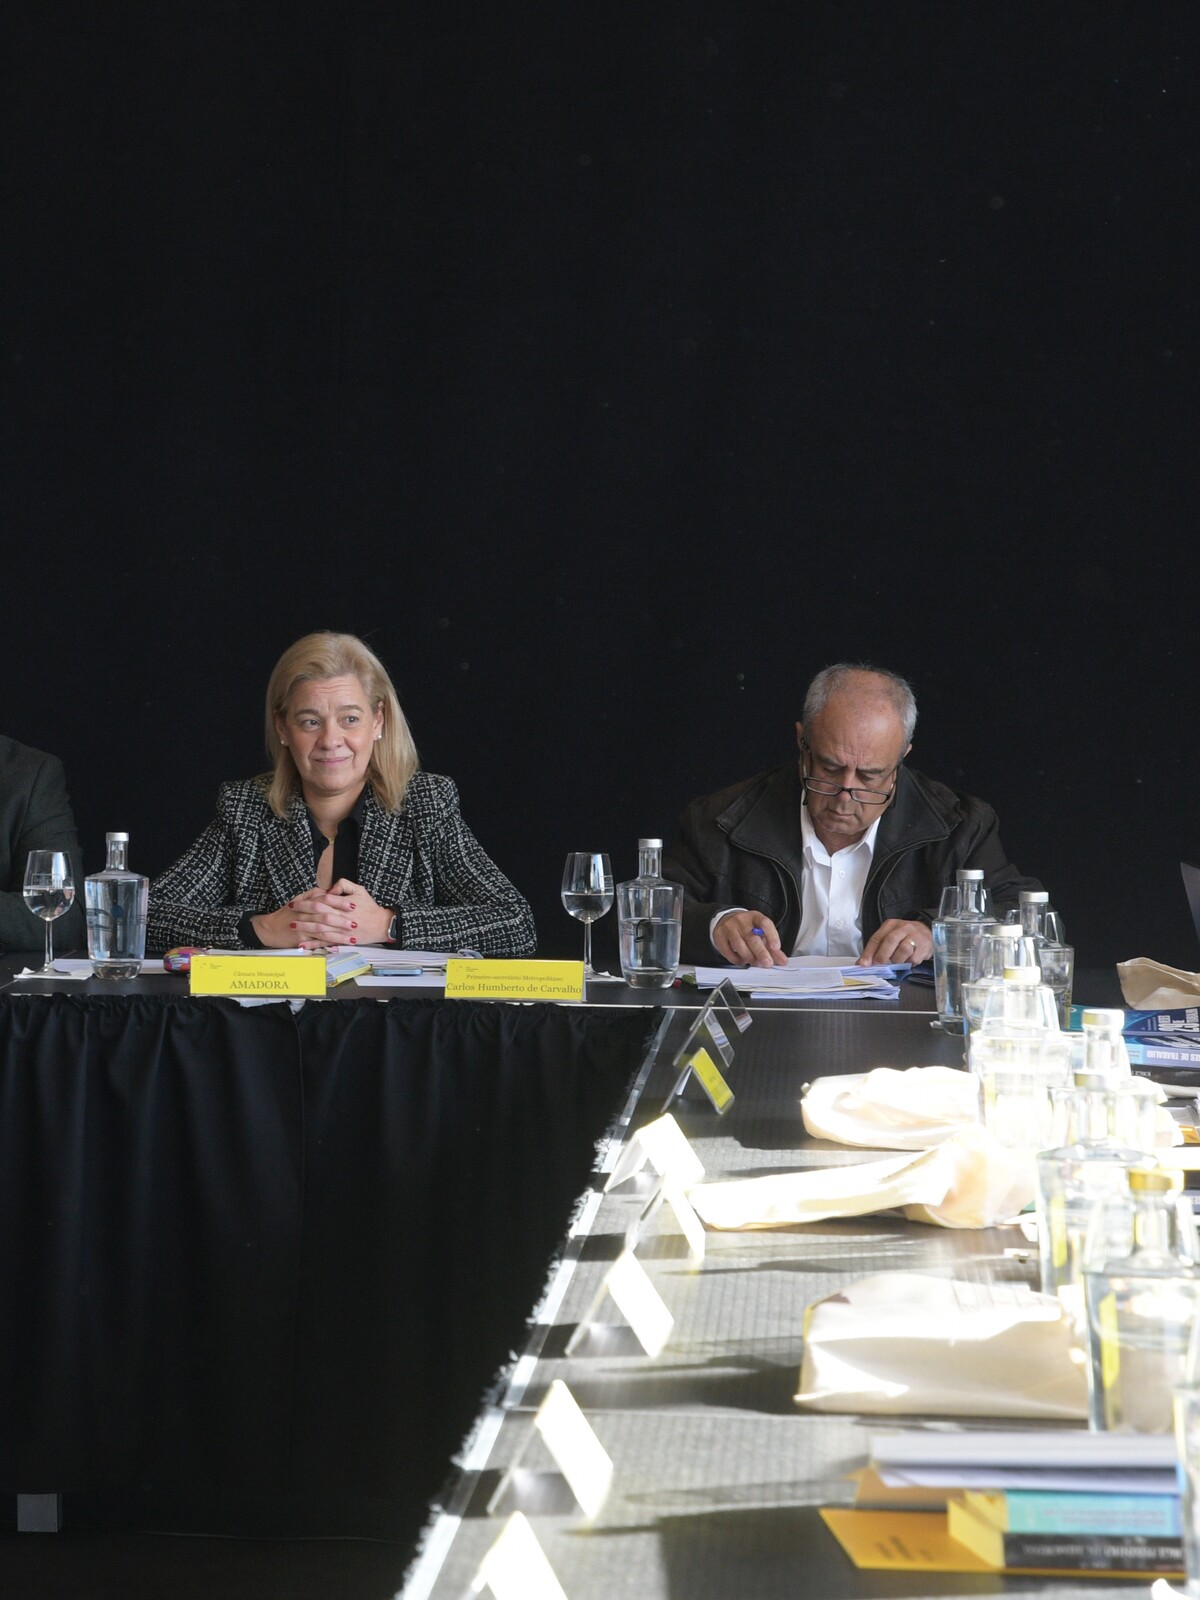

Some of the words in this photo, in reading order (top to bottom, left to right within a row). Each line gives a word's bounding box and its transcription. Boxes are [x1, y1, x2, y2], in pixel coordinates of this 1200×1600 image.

[229, 980, 289, 990] AMADORA
[446, 983, 475, 991] Carlos
[478, 983, 525, 992] Humberto
[527, 984, 539, 993] de
[540, 984, 582, 994] Carvalho
[1146, 1050, 1179, 1060] TRABALHO
